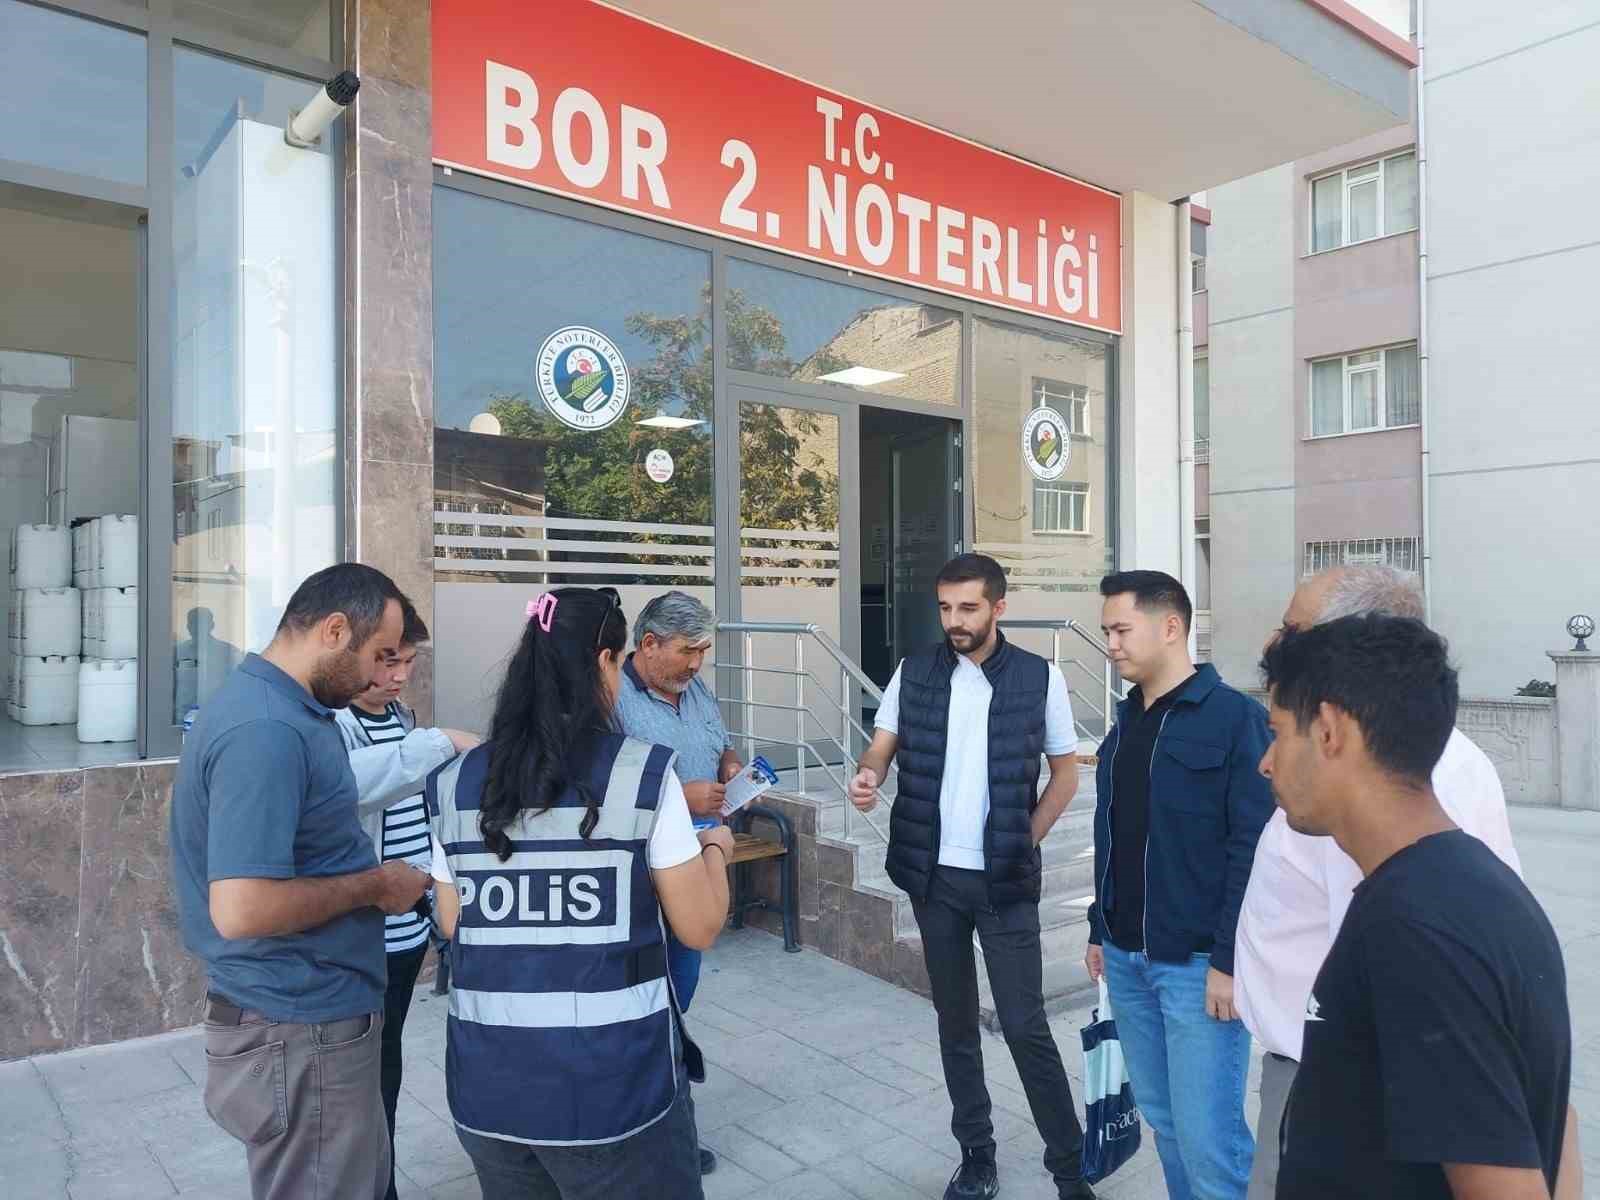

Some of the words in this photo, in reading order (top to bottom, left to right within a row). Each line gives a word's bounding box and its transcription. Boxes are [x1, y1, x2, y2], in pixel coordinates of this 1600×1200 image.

[485, 59, 671, 209] BOR
[719, 139, 779, 239] 2.
[808, 165, 1098, 319] NOTERLİĞİ
[816, 95, 894, 180] T.C.
